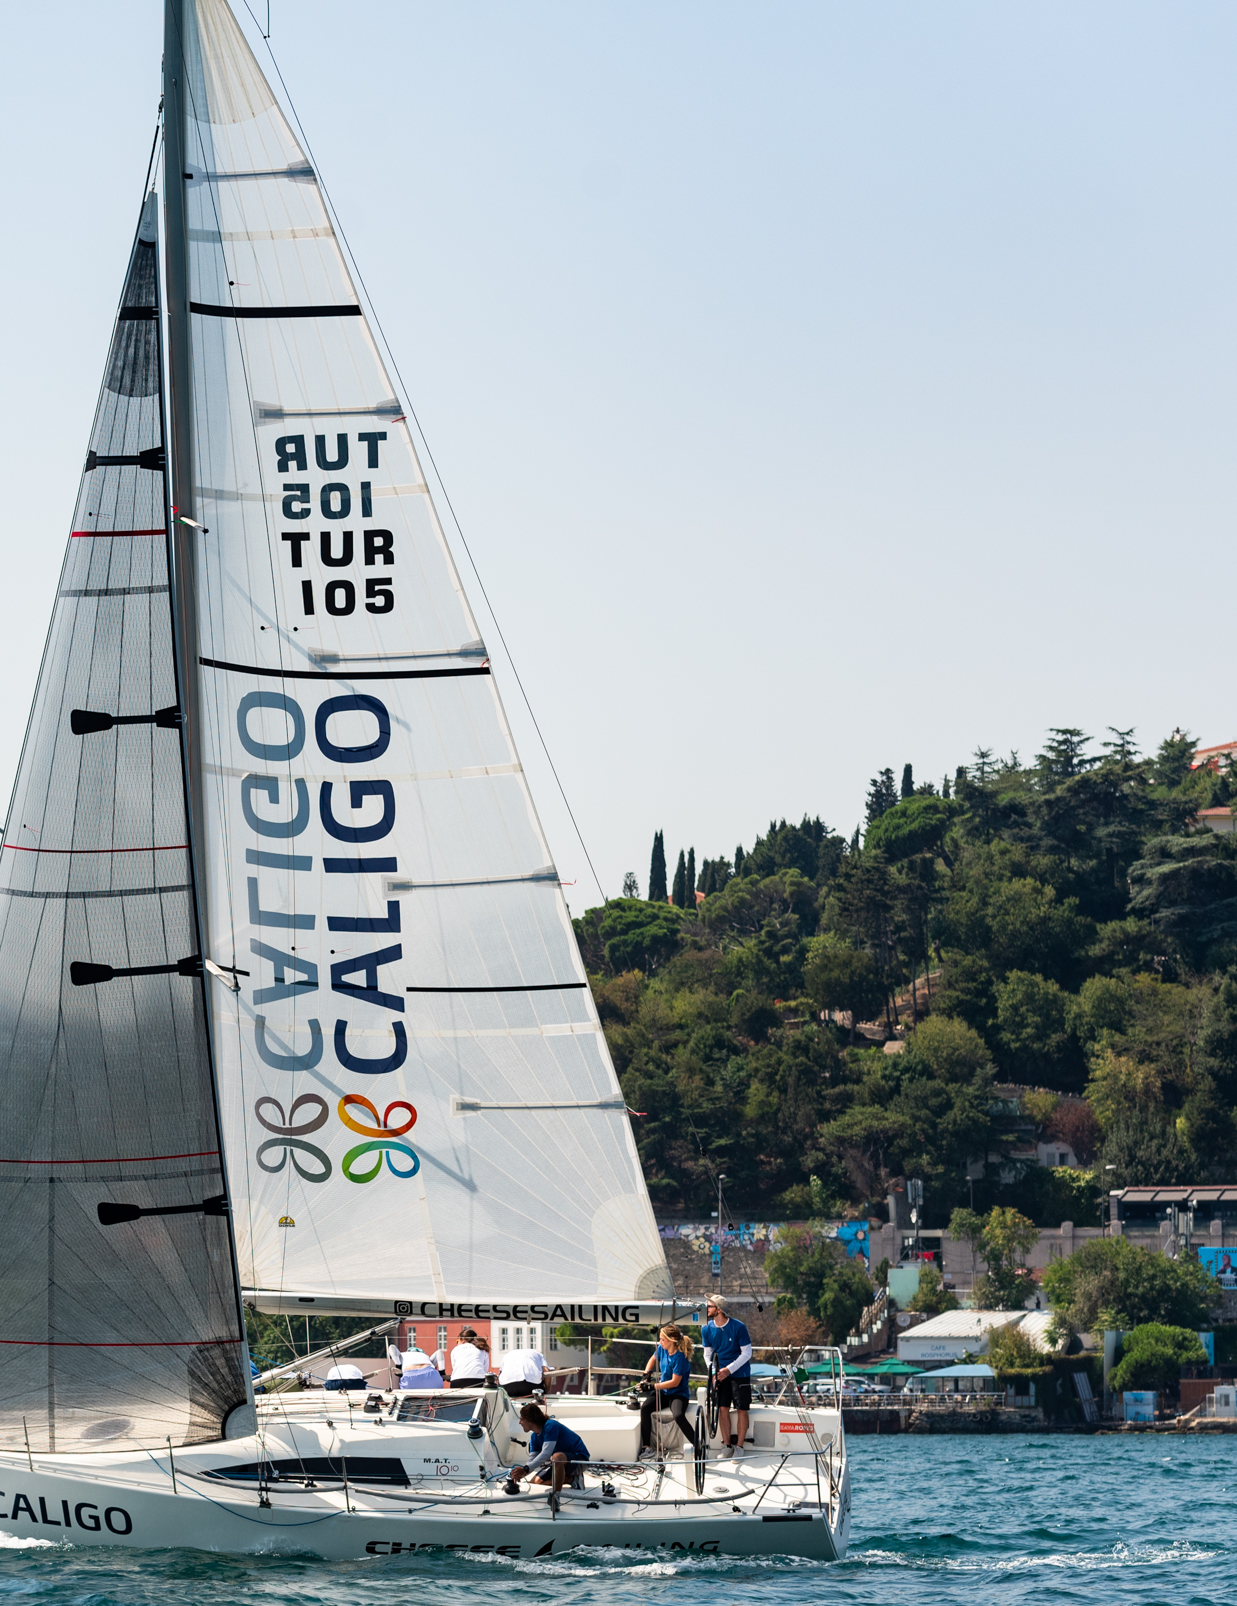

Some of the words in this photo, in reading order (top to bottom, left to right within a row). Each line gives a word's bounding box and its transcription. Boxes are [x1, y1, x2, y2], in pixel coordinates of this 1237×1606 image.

[281, 529, 395, 568] TUR
[301, 577, 395, 616] 105
[314, 693, 408, 1075] CALIGO
[420, 1301, 640, 1323] CHEESESAILING
